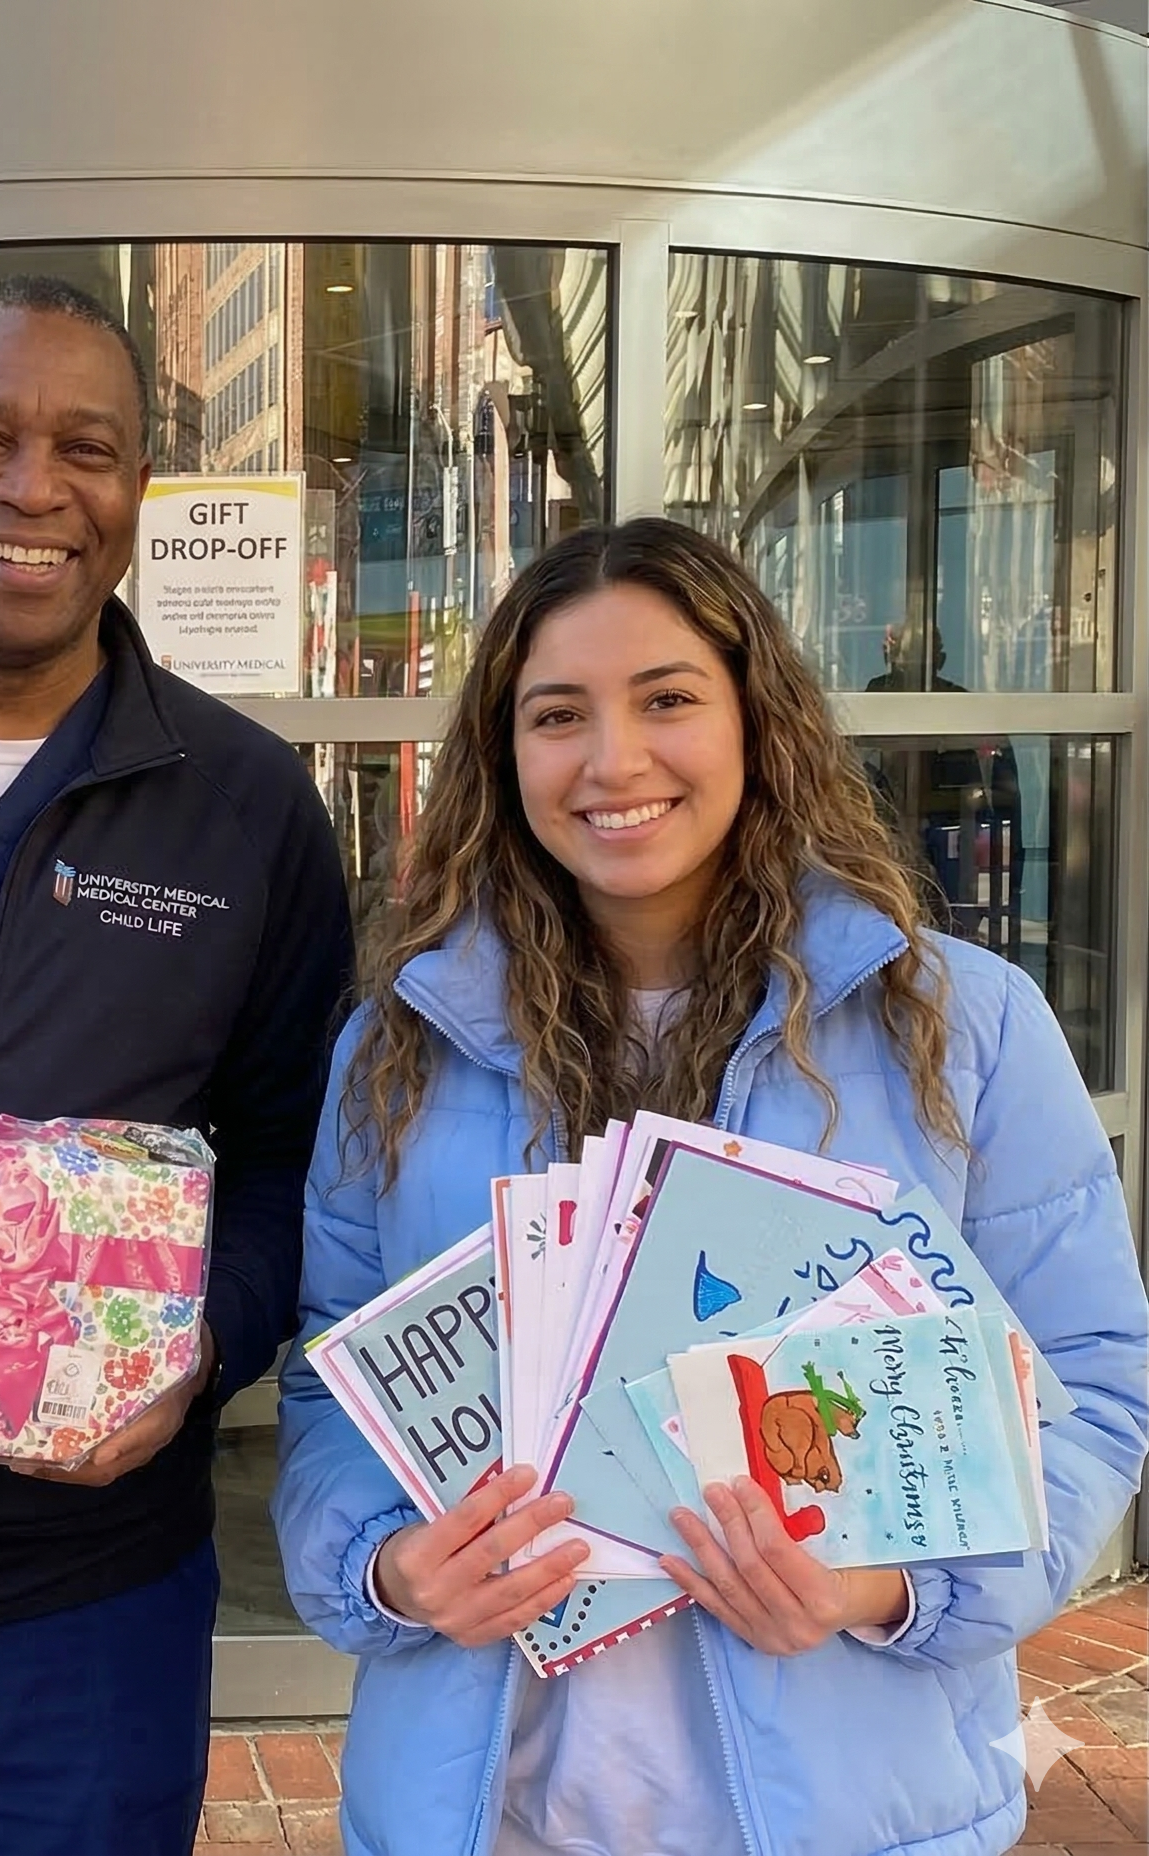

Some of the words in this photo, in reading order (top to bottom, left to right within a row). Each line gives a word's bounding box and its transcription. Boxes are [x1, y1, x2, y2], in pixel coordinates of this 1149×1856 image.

[189, 502, 249, 525] GIFT
[151, 537, 287, 560] DROP-OFF
[173, 659, 235, 670] UNIVERSITY
[237, 659, 286, 669] MEDICAL
[77, 887, 138, 908] MEDICAL
[141, 898, 197, 918] CENTER
[78, 873, 161, 897] UNIVERSITY
[164, 886, 230, 910] MEDICAL
[100, 910, 144, 929] CHILD
[148, 917, 183, 937] LIFE
[359, 1275, 497, 1412] HAPP
[869, 1325, 906, 1396] Merry
